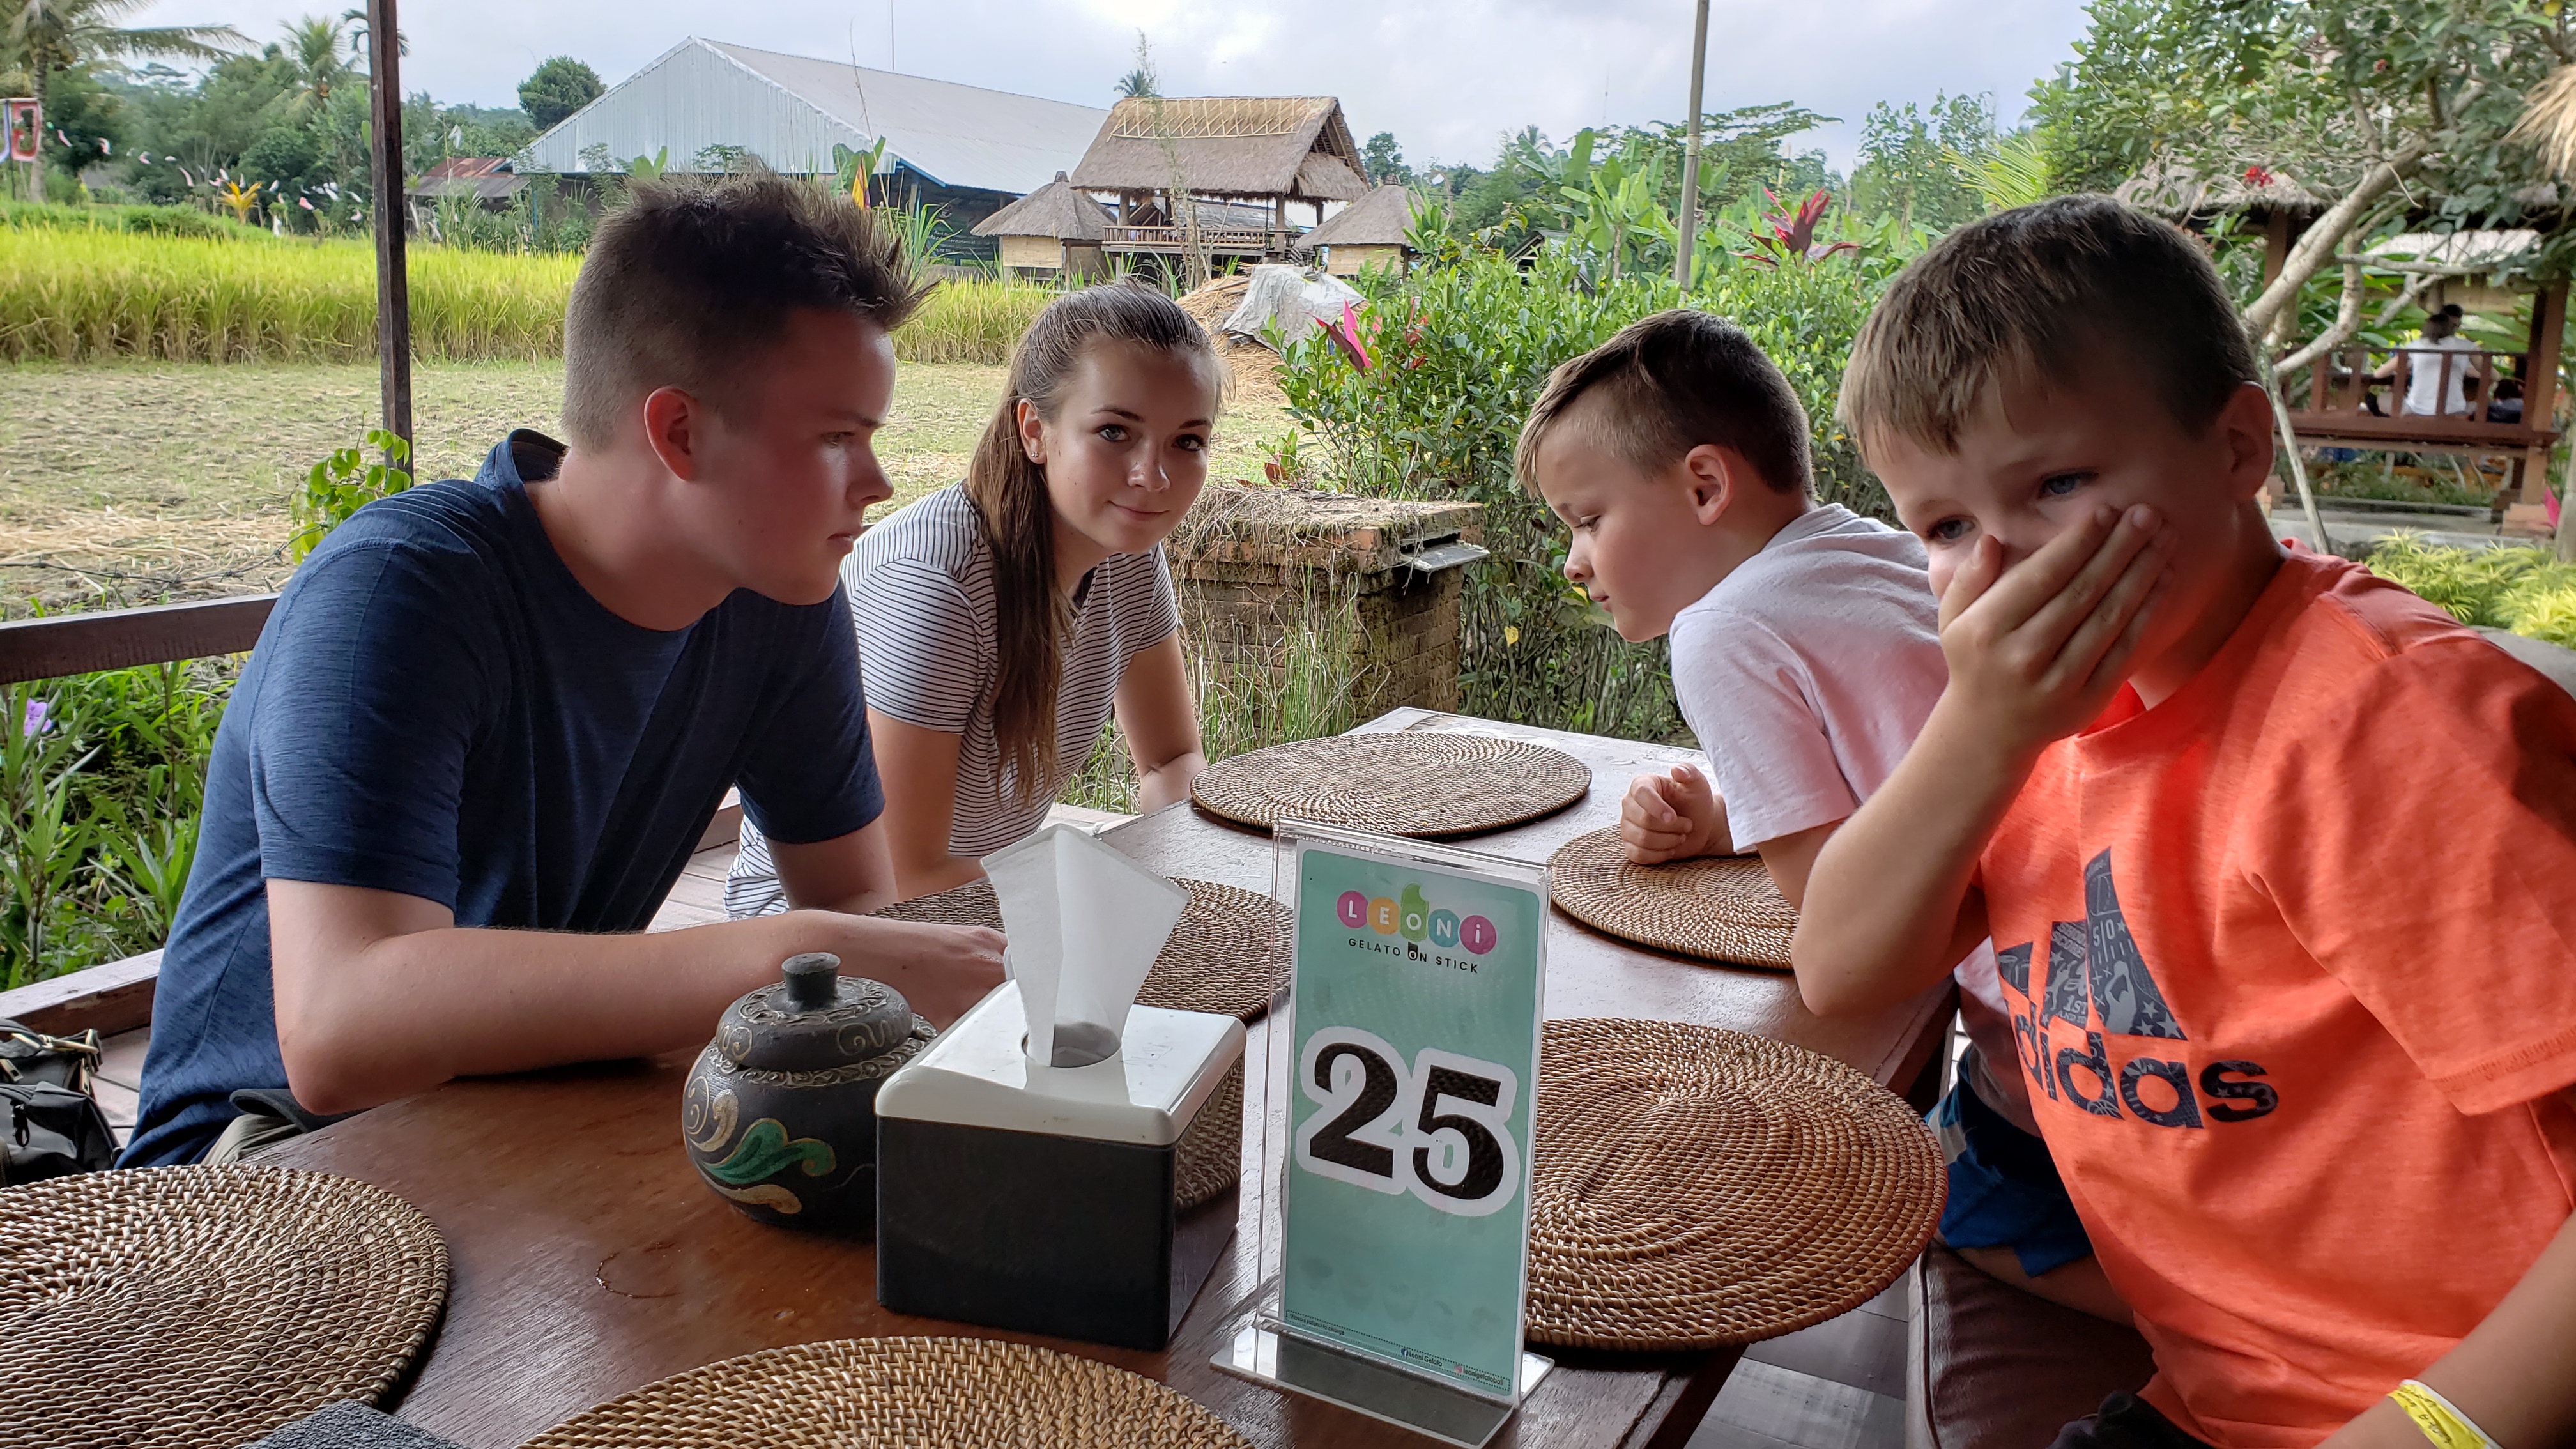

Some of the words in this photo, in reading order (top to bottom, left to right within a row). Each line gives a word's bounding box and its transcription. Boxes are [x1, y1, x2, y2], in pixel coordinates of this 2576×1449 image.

[1348, 937, 1401, 957] GELATO
[1407, 950, 1428, 963] ON
[1436, 956, 1479, 974] STICK
[1308, 1041, 1505, 1201] 25
[1409, 1351, 1423, 1361] Leoni
[1423, 1354, 1443, 1368] Gelato
